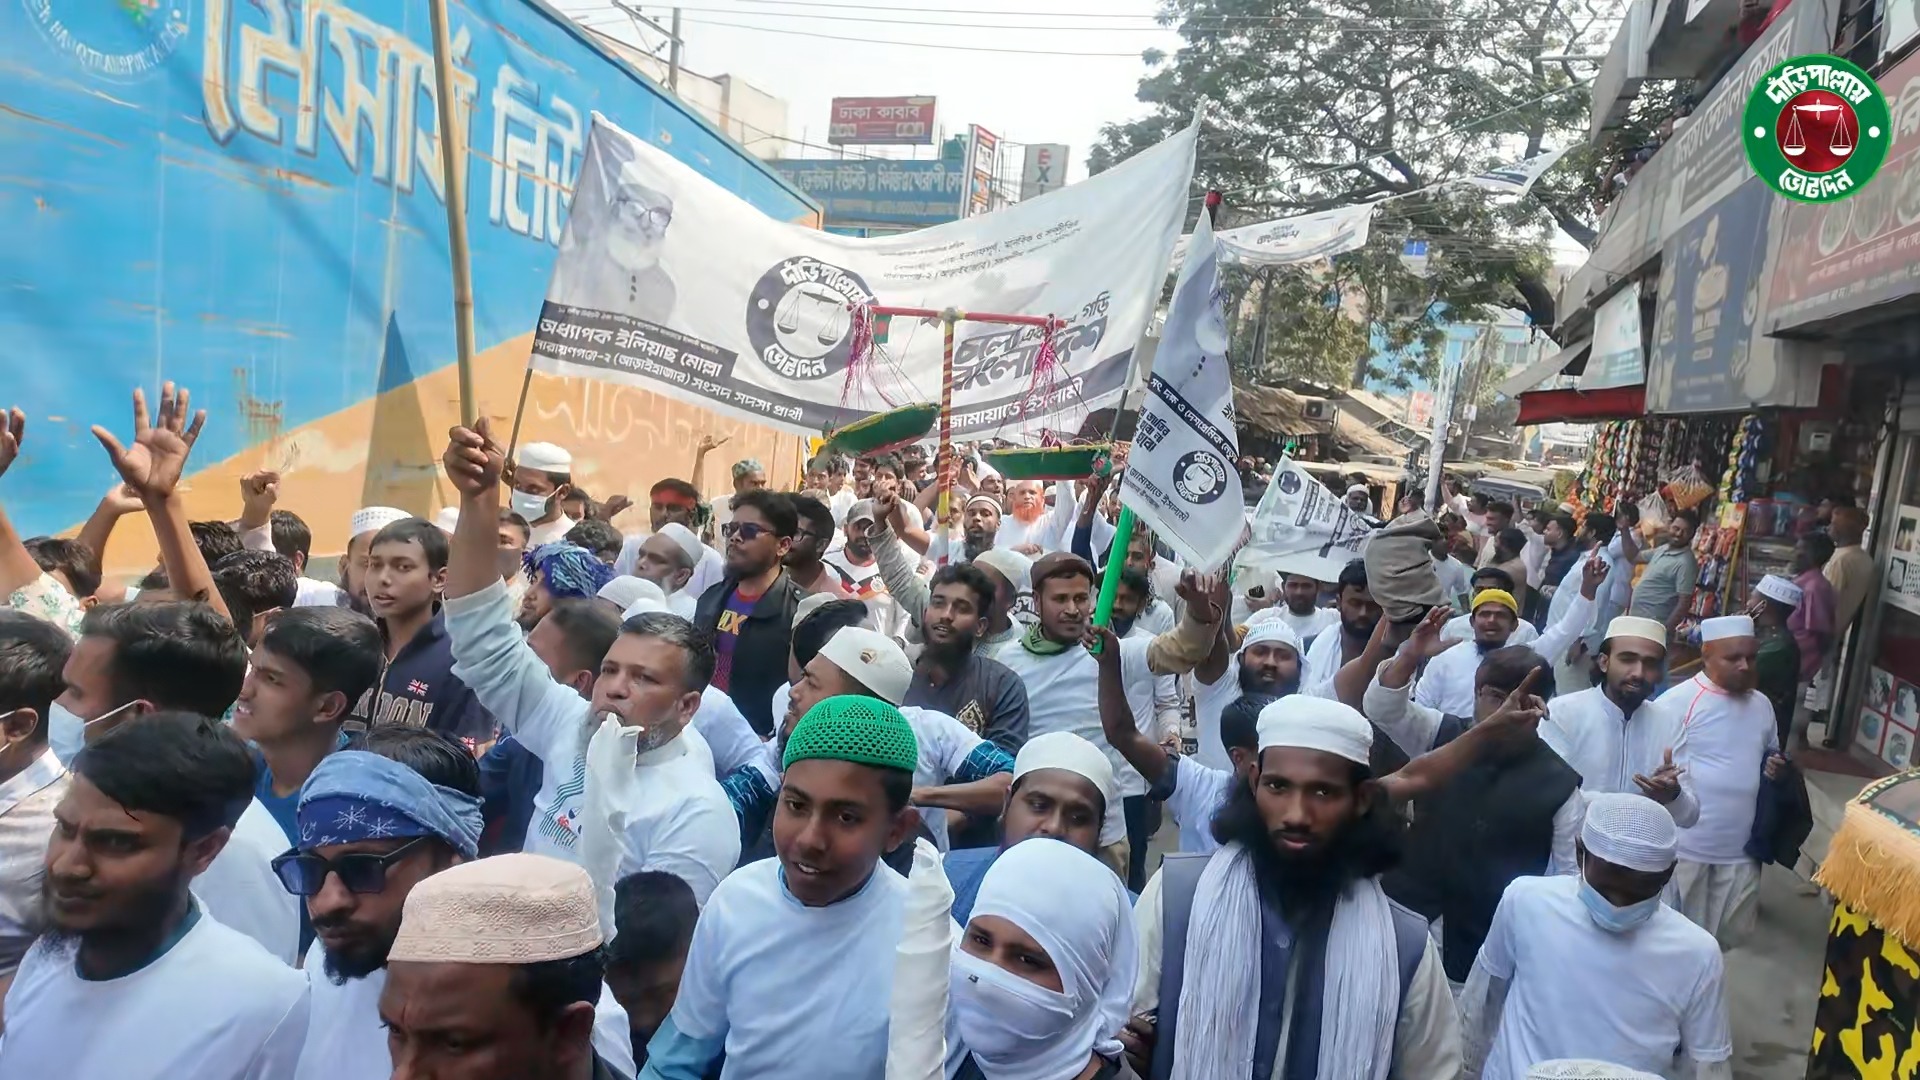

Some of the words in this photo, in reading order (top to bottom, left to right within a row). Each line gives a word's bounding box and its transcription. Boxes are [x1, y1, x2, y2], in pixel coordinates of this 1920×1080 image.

[840, 106, 871, 119] ঢাকা
[877, 105, 920, 119] কাবাব
[540, 317, 613, 346] অধ্যাপক
[614, 328, 678, 364] ইলিয়াছ
[680, 350, 722, 378] মোল্লা
[692, 377, 732, 401] সংসদ
[735, 391, 772, 414] সদস্য
[773, 403, 804, 422] প্রার্থী
[1177, 402, 1185, 413] ও
